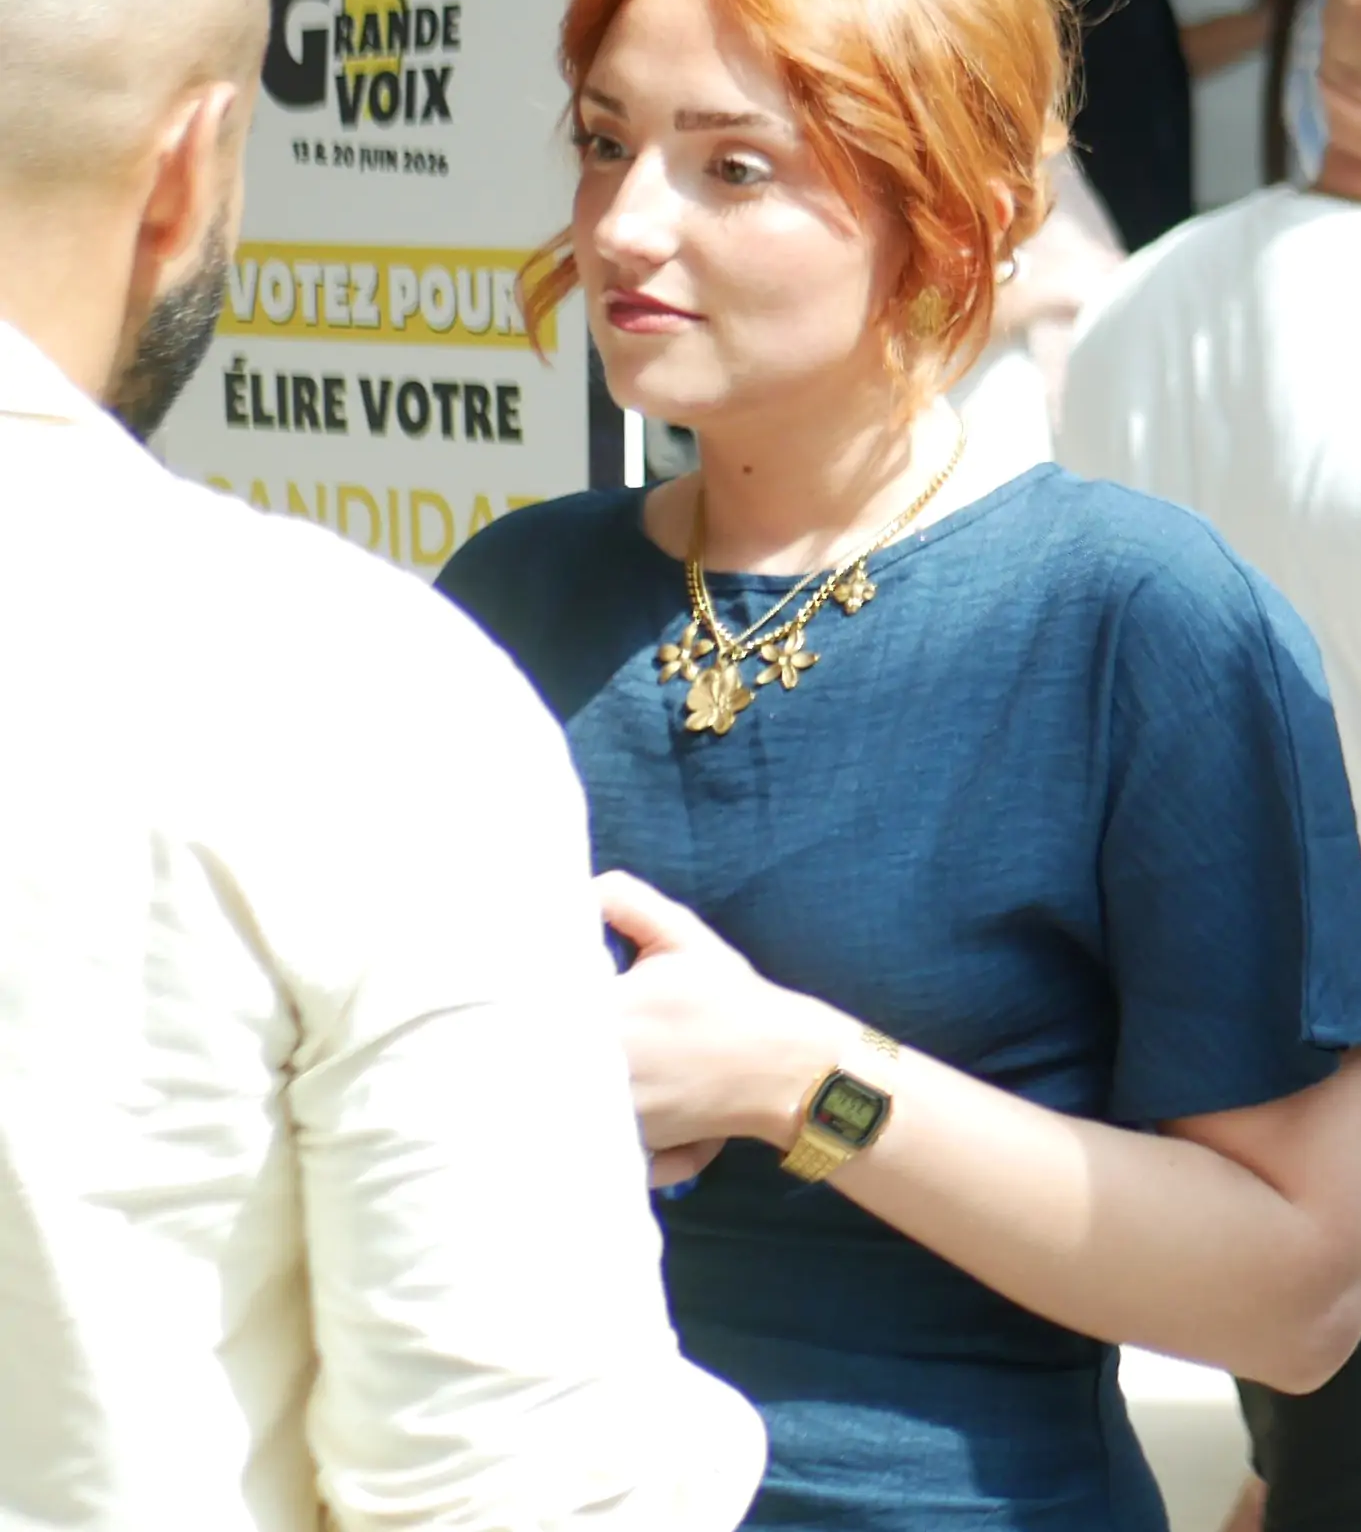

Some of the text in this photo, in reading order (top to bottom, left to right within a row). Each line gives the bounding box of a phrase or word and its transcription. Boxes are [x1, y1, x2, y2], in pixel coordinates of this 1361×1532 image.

[336, 67, 454, 129] VOIX
[333, 143, 355, 169] 20
[359, 146, 399, 174] JUIN
[402, 150, 450, 178] 2026
[229, 259, 528, 336] VOTEZ POUR
[223, 351, 523, 445] ÉLIRE VOTRE
[206, 475, 548, 568] ANDIDA
